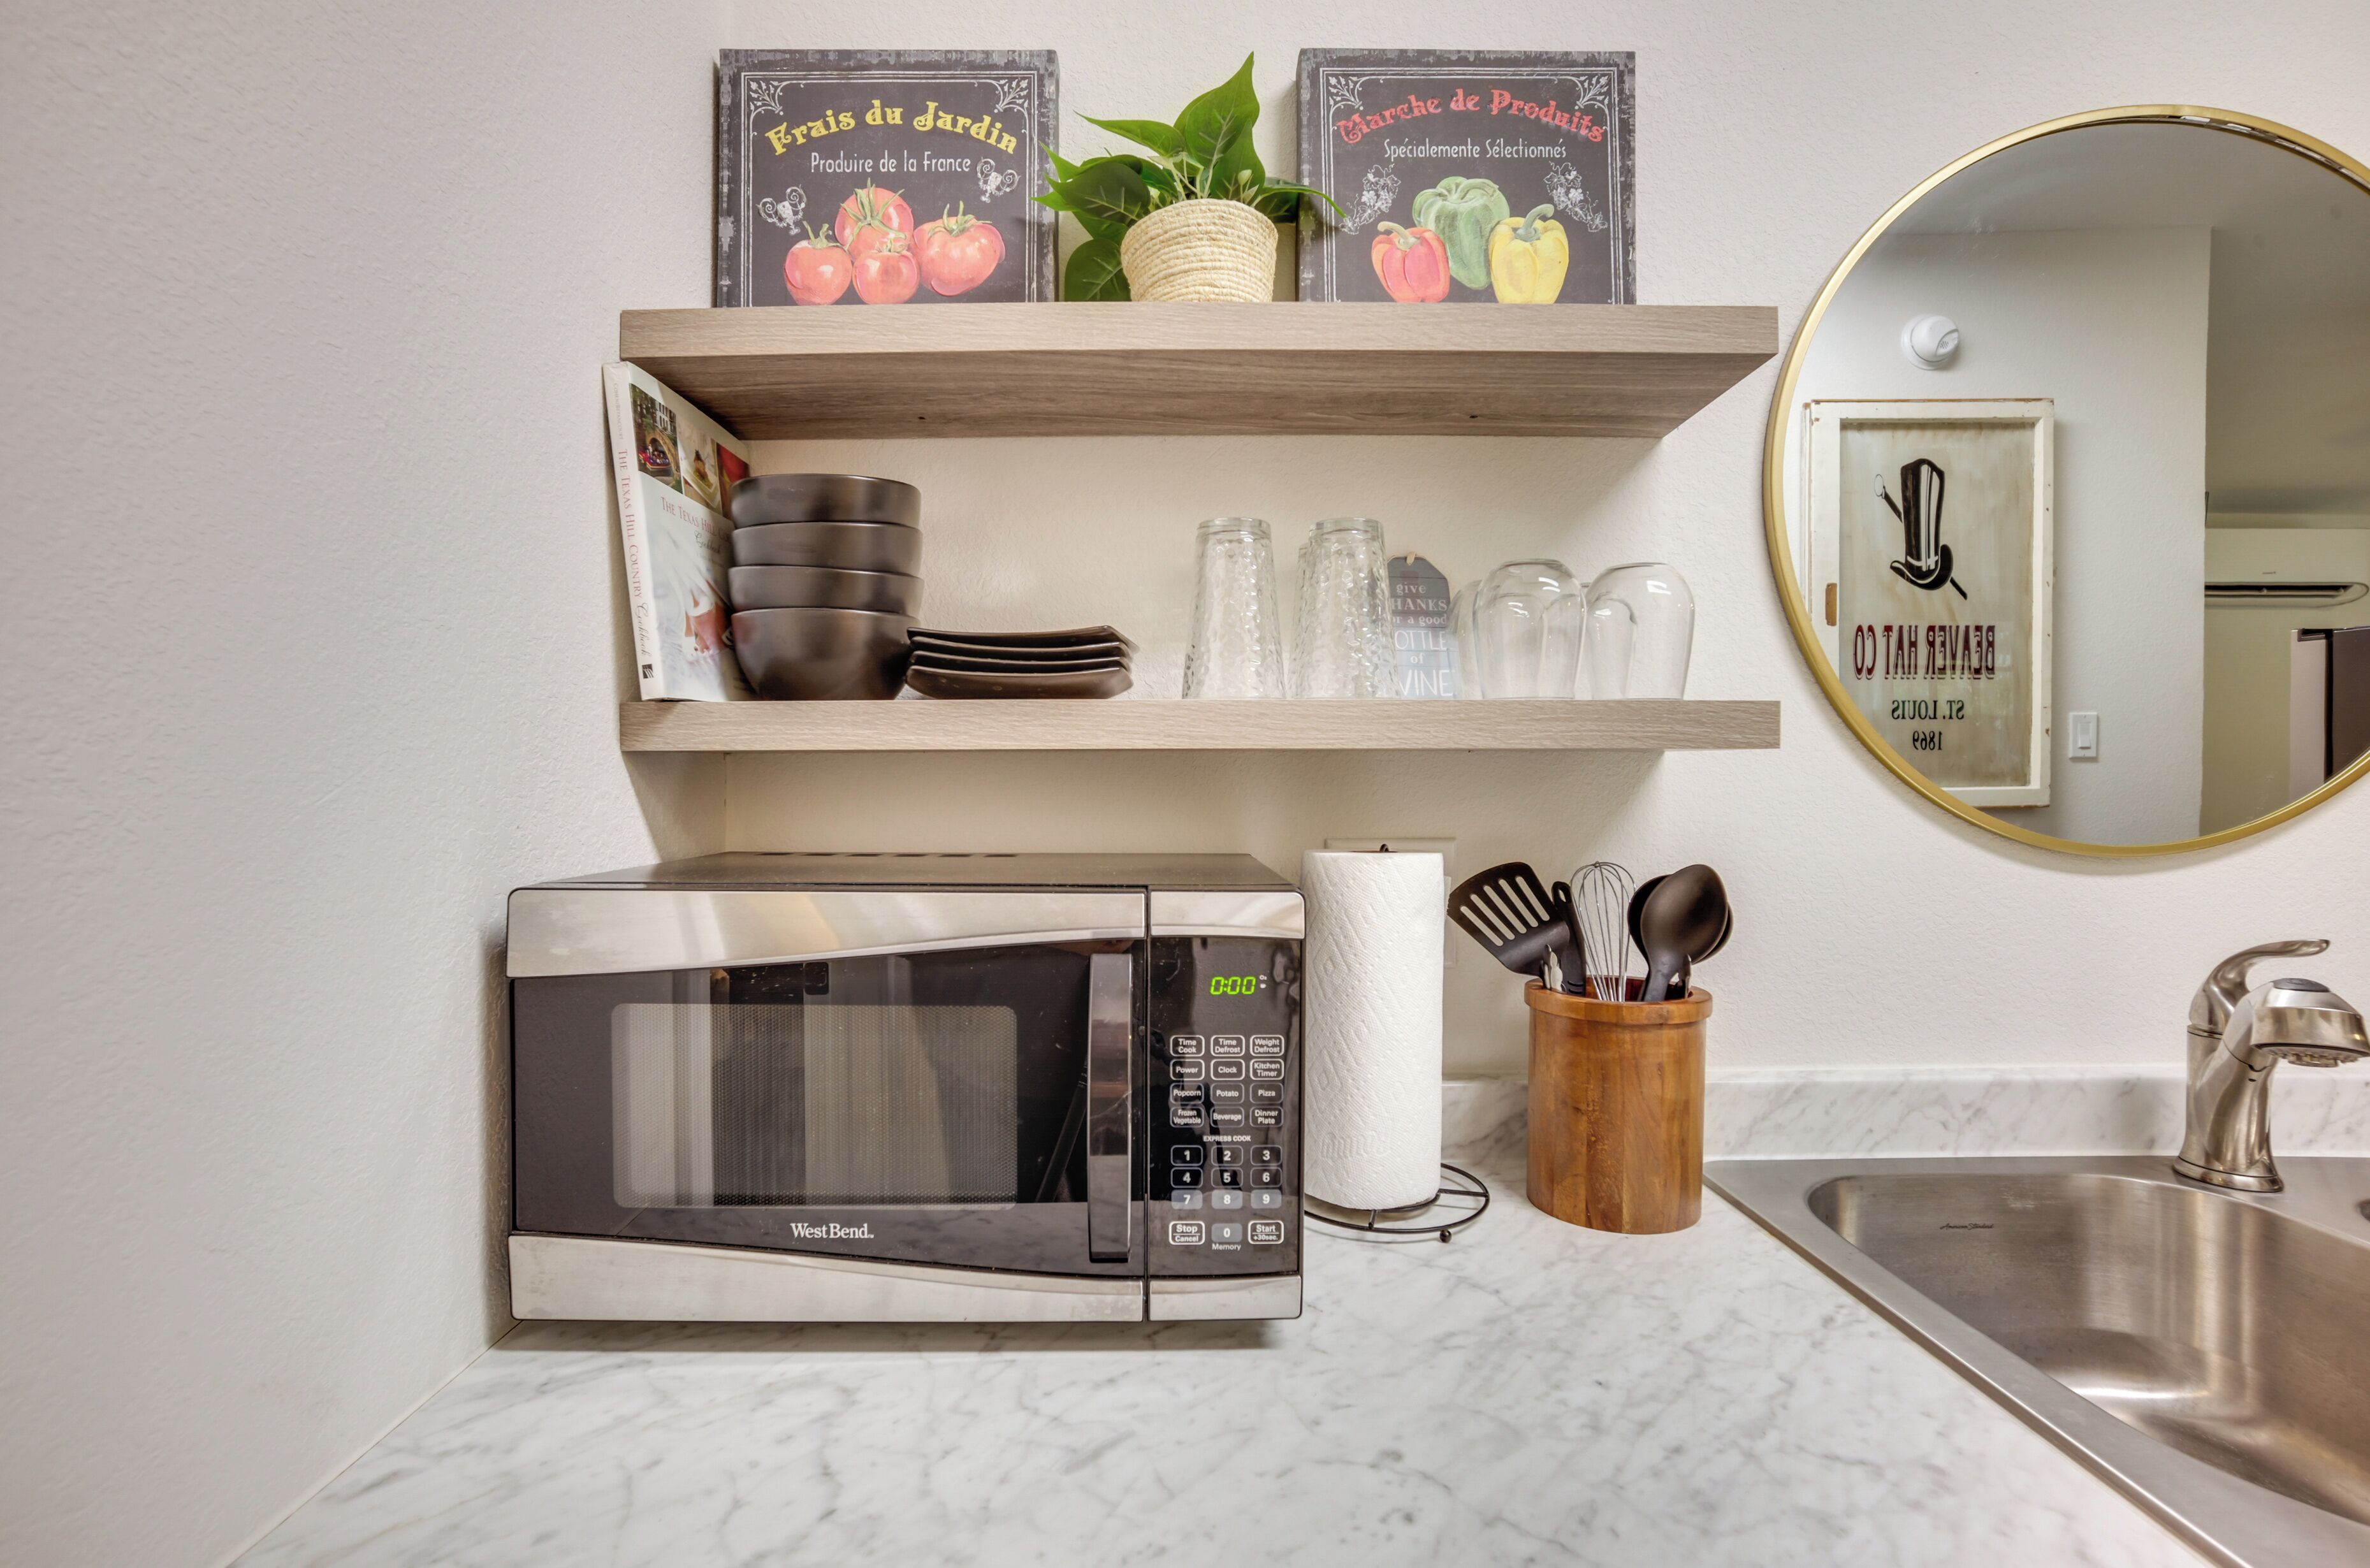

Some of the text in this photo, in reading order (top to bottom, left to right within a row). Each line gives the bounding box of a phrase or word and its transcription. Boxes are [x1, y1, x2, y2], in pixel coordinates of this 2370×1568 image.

[1336, 88, 1605, 144] Marche de Produits
[765, 99, 1019, 156] Frais du Jardin
[1384, 138, 1567, 161] Spécialemente Sélectionnés
[811, 150, 971, 173] Produire de la France
[618, 449, 628, 471] THE
[622, 475, 632, 509] TEXAS
[660, 497, 676, 516] THE
[678, 505, 699, 528] TEXAS
[625, 514, 635, 541] HILL
[629, 544, 642, 598] COUNTRY
[1396, 583, 1427, 596] give
[1391, 598, 1448, 612] HANKS
[1407, 616, 1414, 624] a
[1418, 614, 1448, 627] good
[1395, 630, 1448, 650] OTTLE
[1410, 653, 1426, 664] of
[1210, 976, 1256, 995] 0:00
[1254, 1038, 1279, 1047] Weight
[1184, 1151, 1191, 1161] 1
[1223, 1151, 1231, 1161] 2
[1262, 1150, 1270, 1161] 3
[1182, 1172, 1191, 1183] 4
[1223, 1172, 1231, 1182] 5
[1262, 1172, 1270, 1182] 6
[1184, 1194, 1191, 1205] 7
[1223, 1194, 1231, 1205] 8
[1262, 1194, 1270, 1204] 9
[790, 1223, 828, 1238] West
[1176, 1224, 1198, 1234] Stop
[1223, 1228, 1230, 1237] 0
[1256, 1224, 1276, 1233] Start
